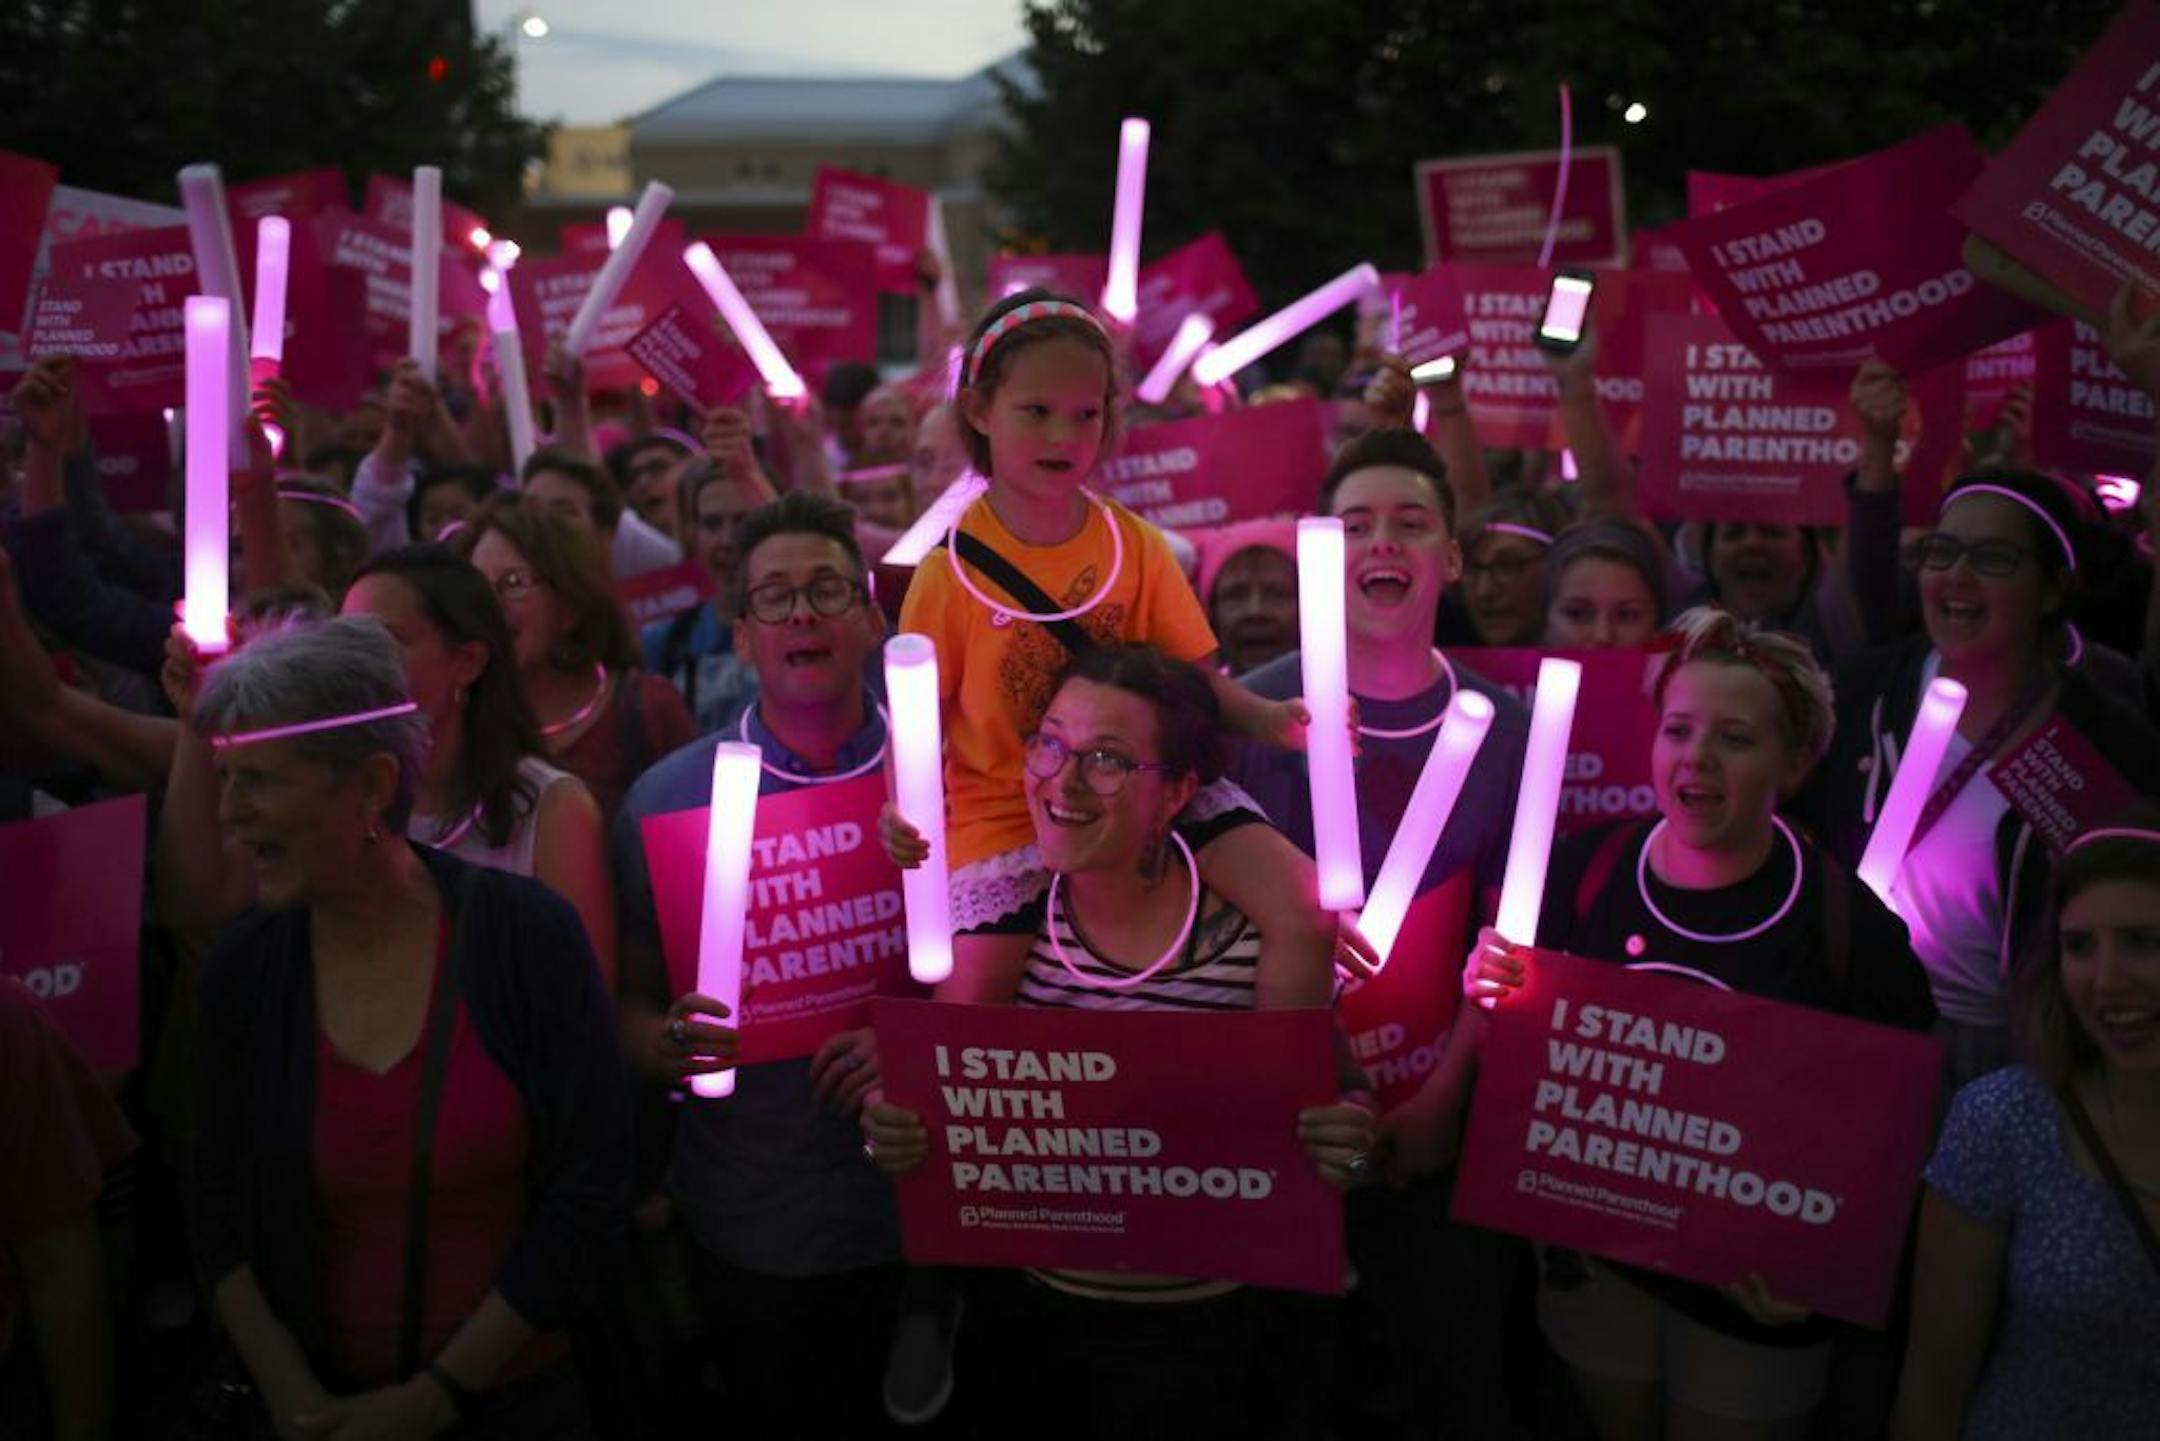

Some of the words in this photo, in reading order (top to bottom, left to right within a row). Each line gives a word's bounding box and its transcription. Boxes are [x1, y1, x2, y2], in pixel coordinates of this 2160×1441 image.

[1711, 244, 1728, 268] I
[1726, 217, 1826, 265] STAND
[99, 253, 193, 279] STAND
[1730, 258, 1806, 294] WITH
[1743, 269, 1882, 320] PLANNED
[1759, 267, 1976, 344] PARENTHOOD
[32, 329, 95, 343] PLANNED
[1686, 344, 1697, 369] I
[1686, 374, 1773, 401] WITH
[1682, 405, 1837, 432] PLANNED
[1117, 447, 1199, 481] STAND
[2022, 749, 2061, 790] WITH
[2035, 737, 2084, 790] STAND
[2010, 759, 2076, 831] PLANNED
[751, 821, 862, 870] TAND
[747, 868, 823, 912] ITH
[745, 890, 901, 949] LANNED
[1550, 997, 1568, 1031] I
[1575, 1003, 1727, 1065] STAND
[934, 1045, 950, 1076] I
[960, 1046, 1117, 1082] STAND
[1547, 1039, 1664, 1095] WITH
[941, 1085, 1065, 1119] WITH
[1534, 1079, 1742, 1156] PLANNED
[946, 1125, 1162, 1157] PLANNED
[951, 1162, 1273, 1200] PARENTHOOD
[1525, 1119, 1837, 1225] PARENTHOOD
[979, 1206, 1038, 1221] Planned
[1039, 1208, 1124, 1225] Parenthood
[1538, 1172, 1596, 1199] Planned
[1597, 1186, 1681, 1220] Parenthood
